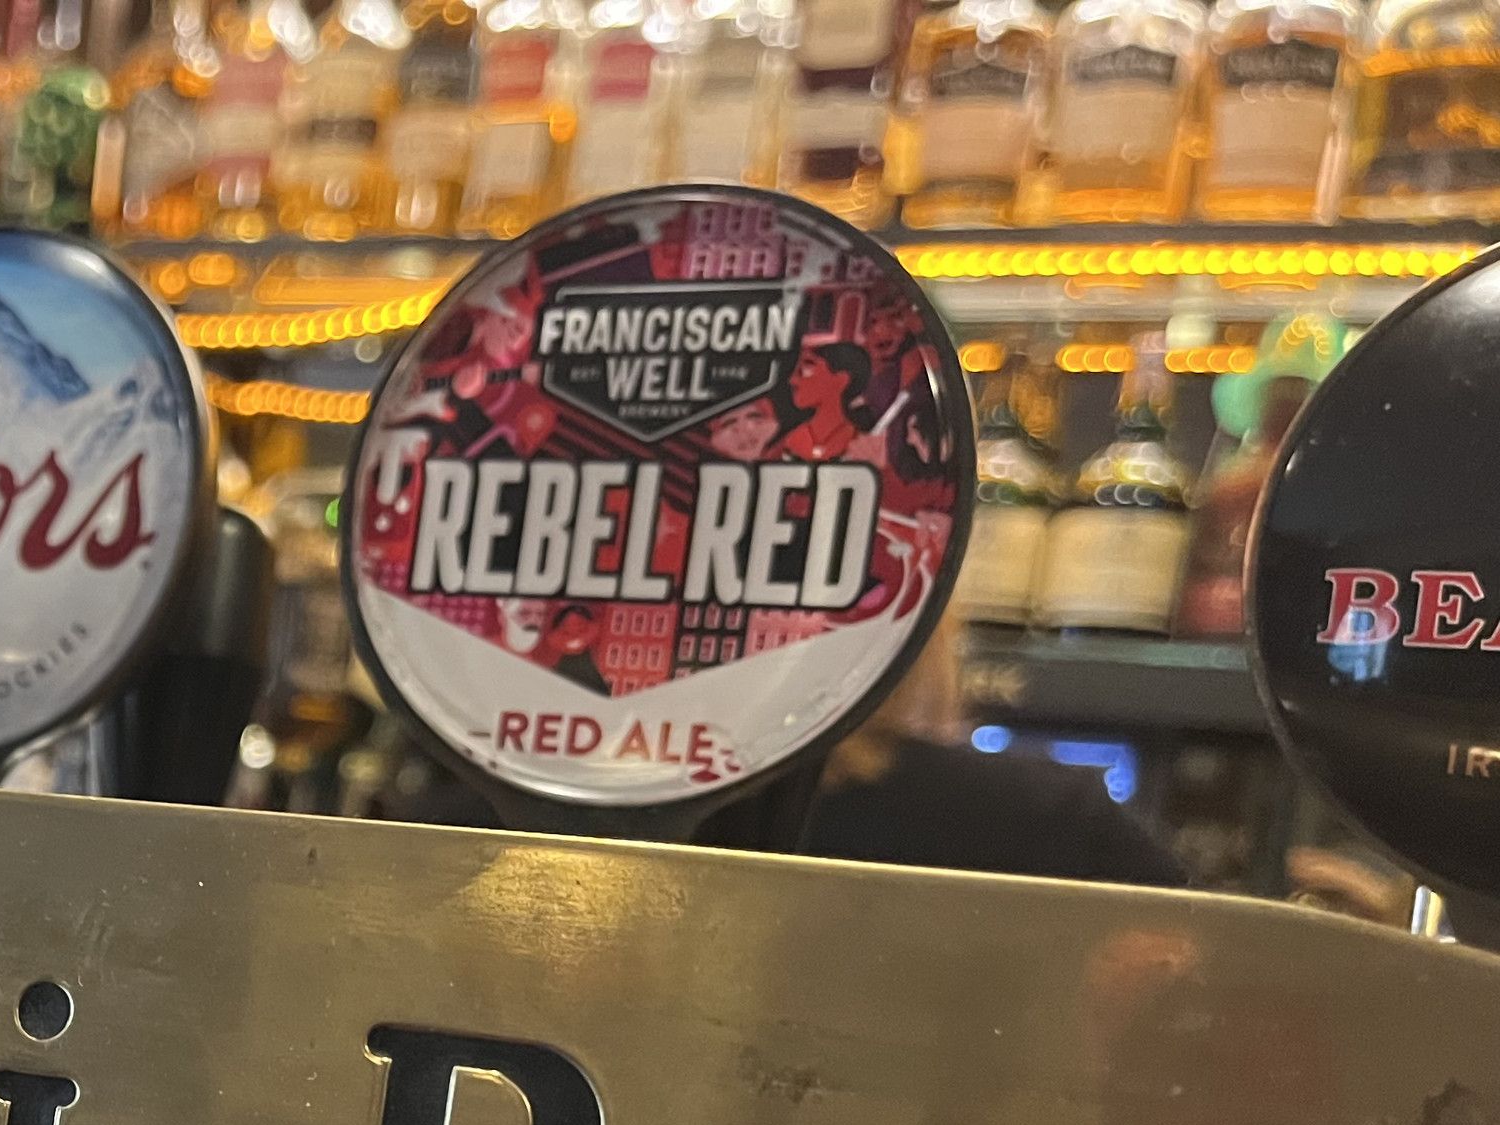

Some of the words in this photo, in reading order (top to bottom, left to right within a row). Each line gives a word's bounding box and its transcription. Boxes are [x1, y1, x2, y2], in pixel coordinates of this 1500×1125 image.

[538, 304, 798, 353] FRANCISCAN
[605, 355, 714, 400] WELL
[412, 460, 673, 600] REBEL
[685, 463, 879, 608] RED
[1316, 567, 1500, 651] BE
[498, 711, 602, 756] RED
[615, 719, 713, 767] ALE
